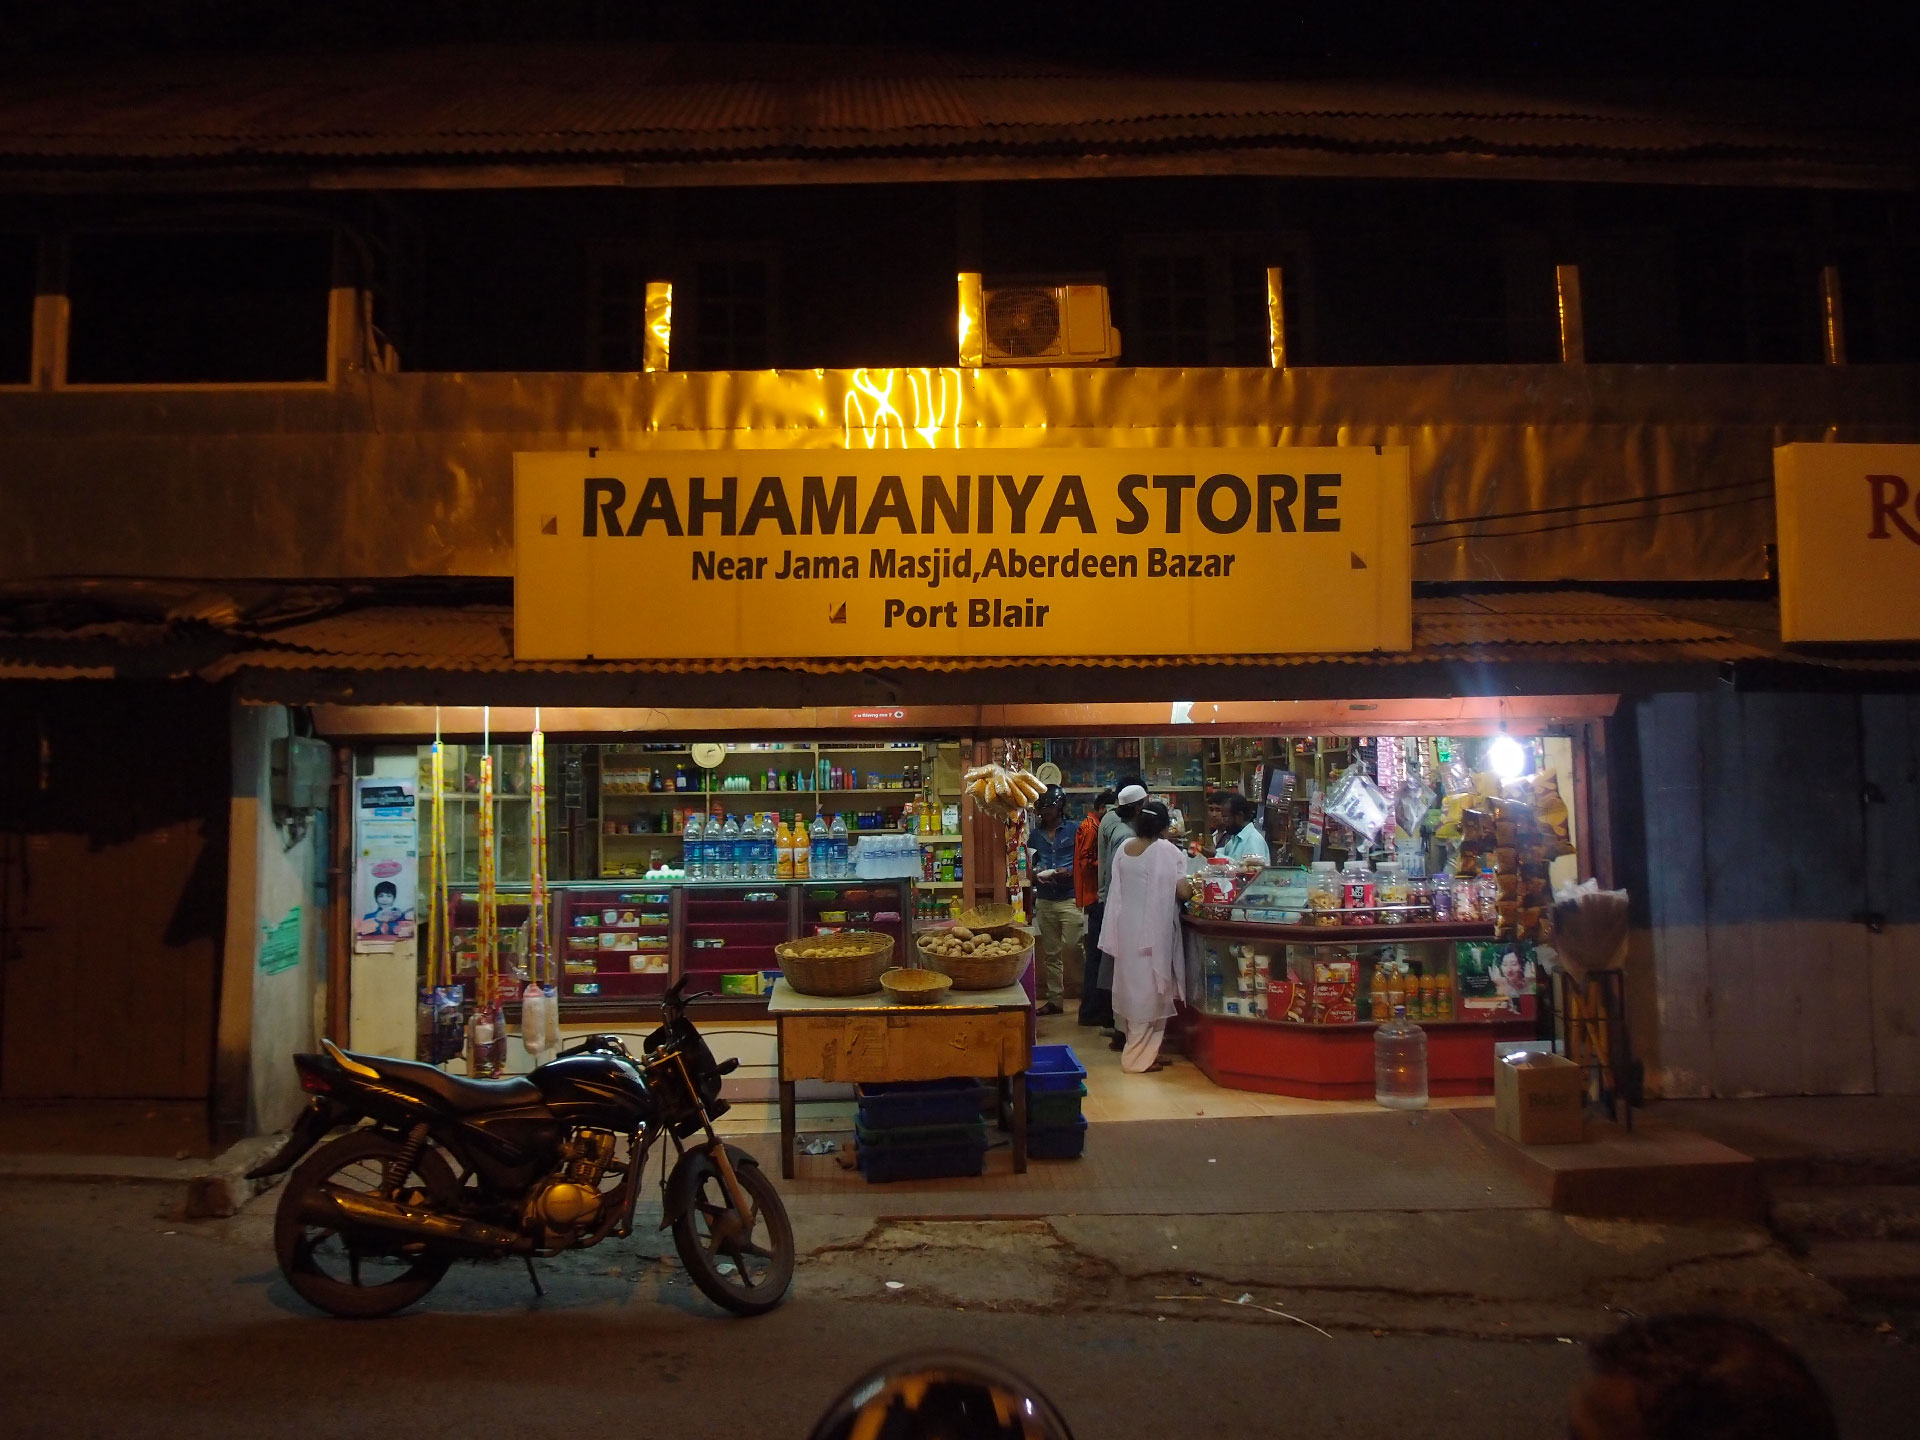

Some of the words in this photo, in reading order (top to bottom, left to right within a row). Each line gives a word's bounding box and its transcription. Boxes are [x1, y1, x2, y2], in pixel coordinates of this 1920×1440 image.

[583, 475, 1097, 537] RAHAMANIYA
[1116, 473, 1342, 535] STORE
[1864, 474, 1920, 546] R
[692, 550, 768, 580] Near
[775, 550, 859, 580] Jama
[1147, 547, 1236, 578] Bazar
[884, 598, 958, 628] Port
[968, 597, 1050, 628] Blair
